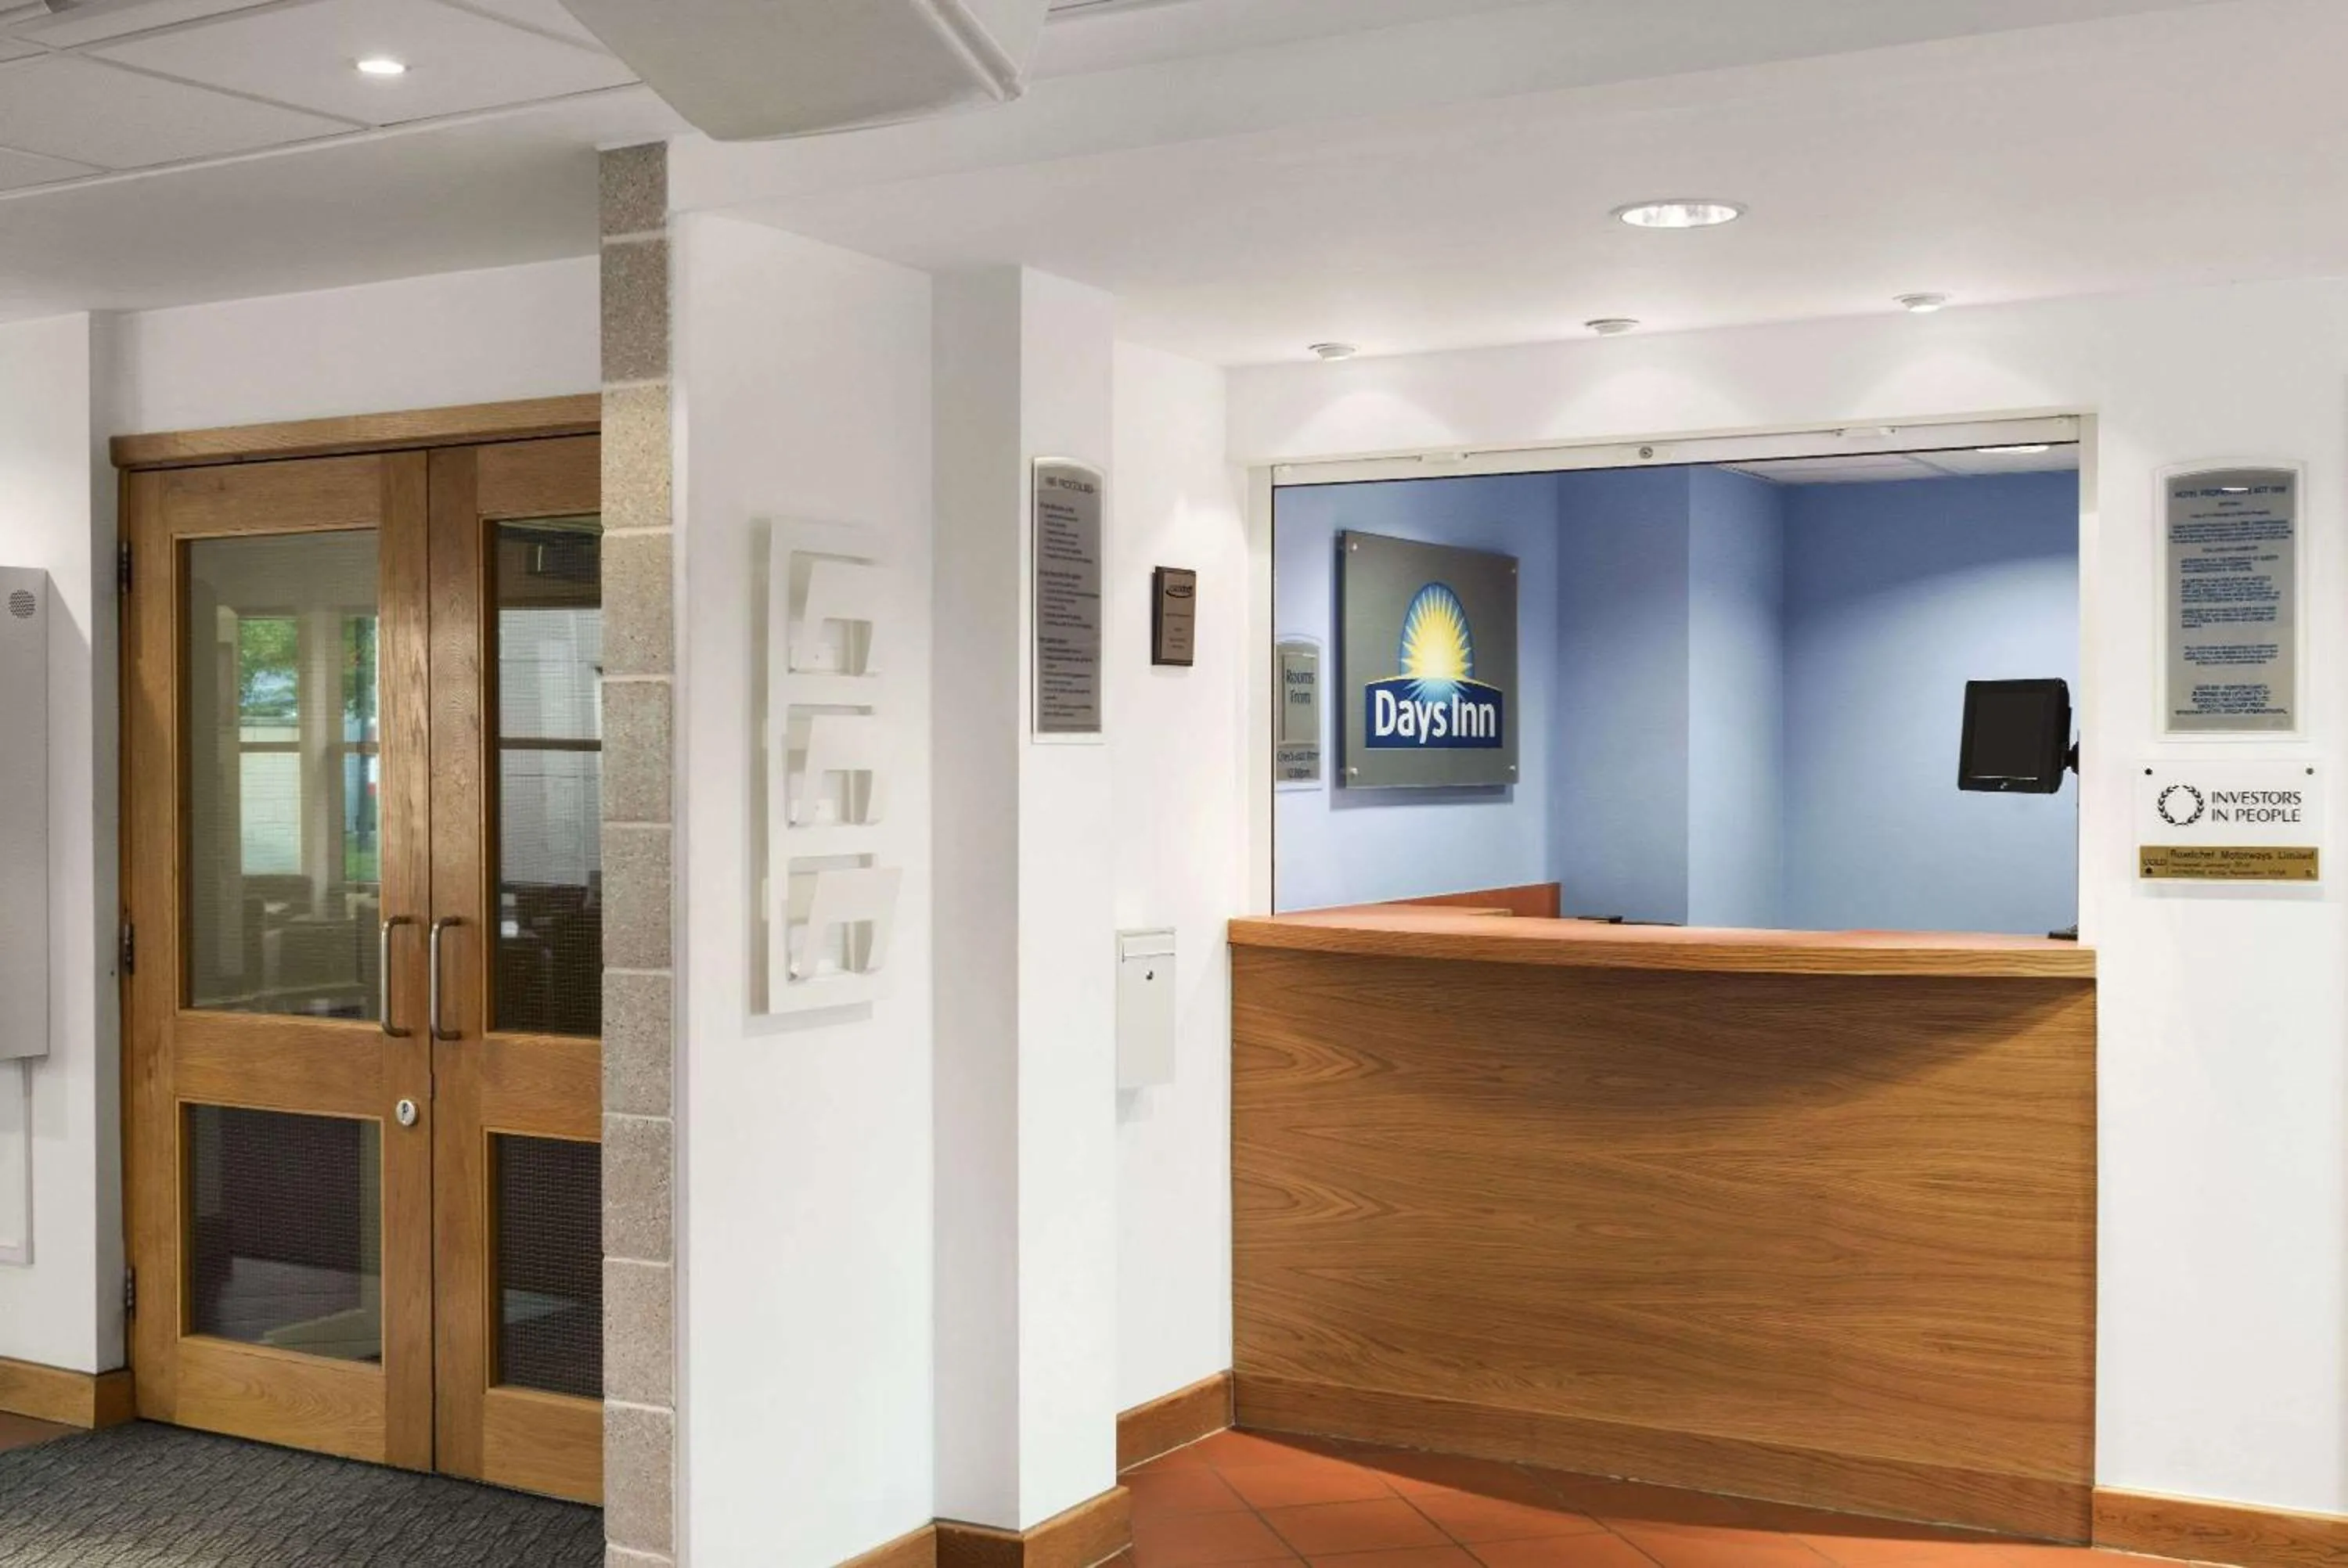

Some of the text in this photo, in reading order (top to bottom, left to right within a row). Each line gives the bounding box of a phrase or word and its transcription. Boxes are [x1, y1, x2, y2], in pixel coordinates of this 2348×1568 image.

[1286, 669, 1314, 685] Rooms
[1374, 689, 1496, 744] Days Inn
[2212, 791, 2303, 804] INVESTORS
[2212, 808, 2302, 822] IN PEOPLE
[2220, 851, 2273, 861] Motorways
[2278, 851, 2315, 860] Limited
